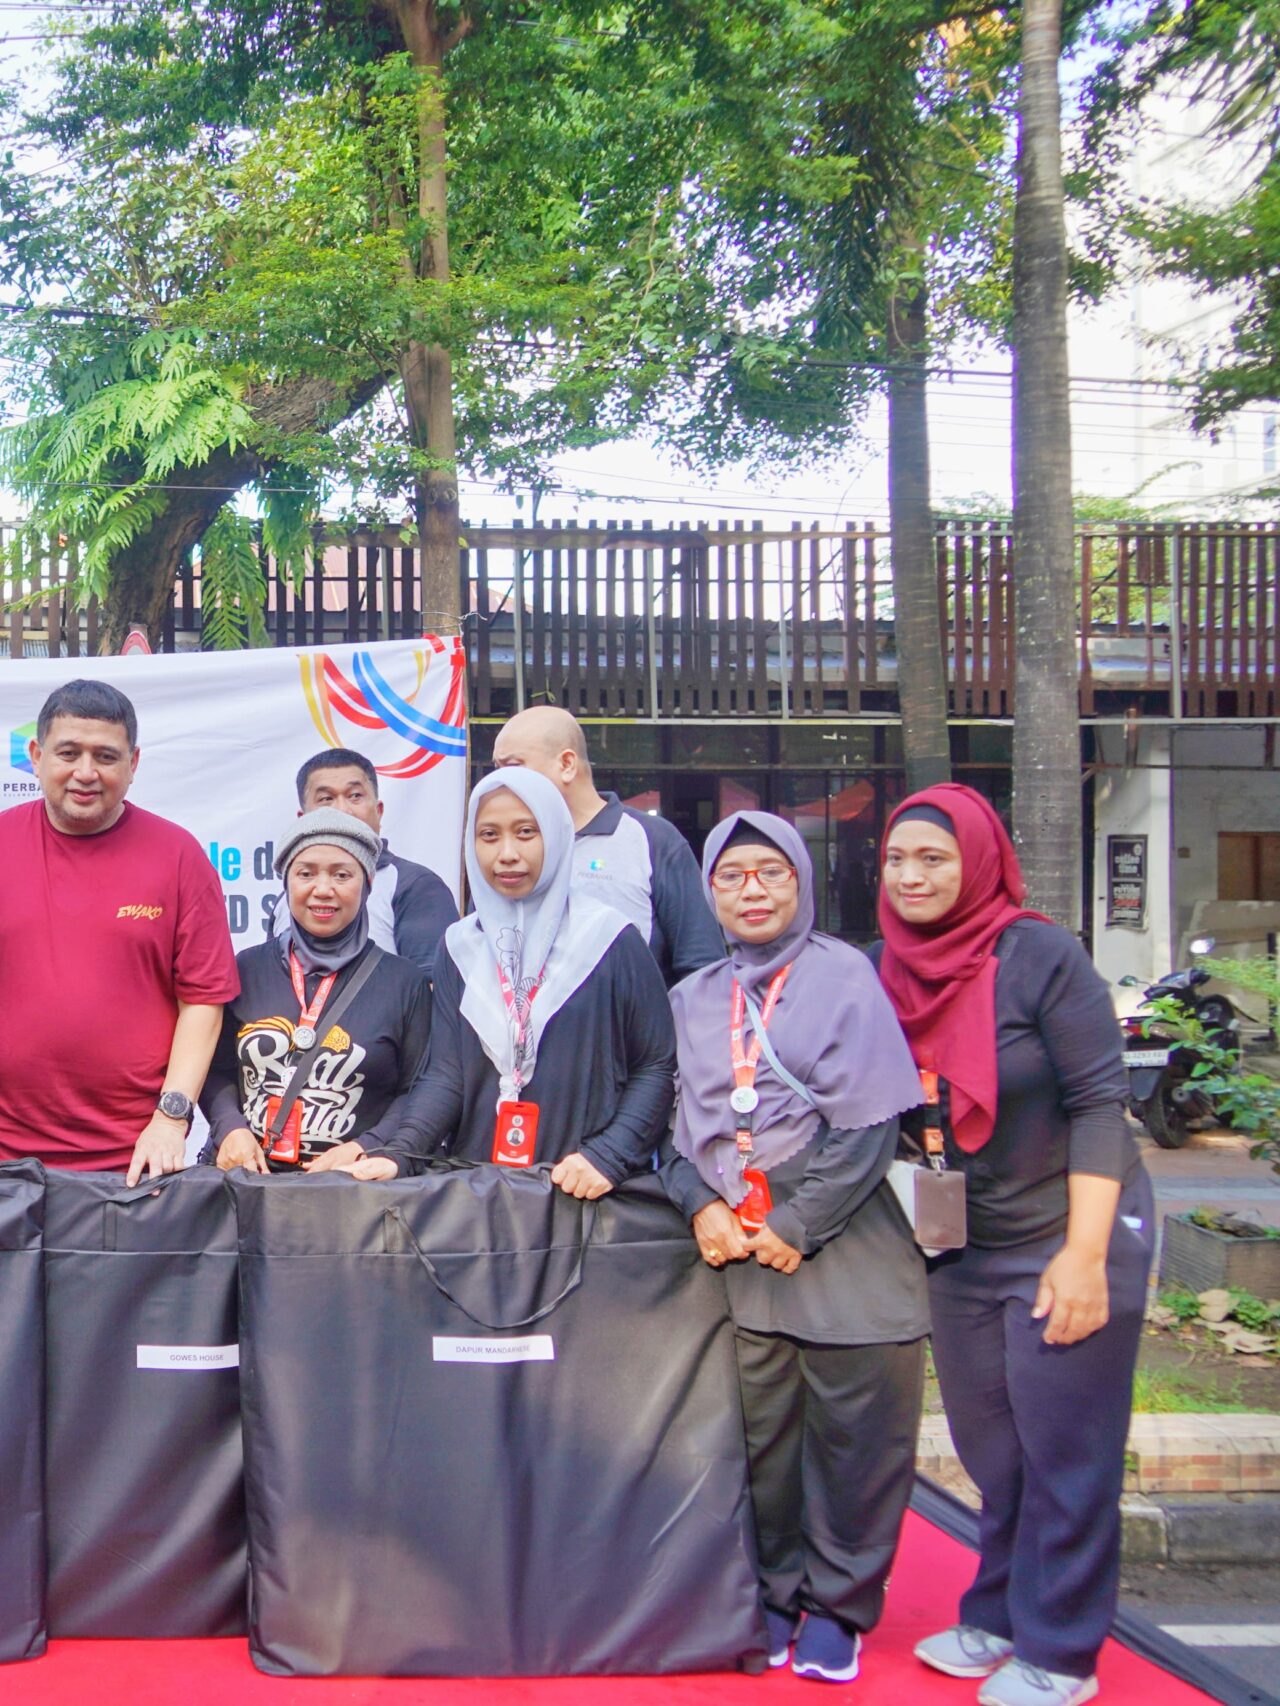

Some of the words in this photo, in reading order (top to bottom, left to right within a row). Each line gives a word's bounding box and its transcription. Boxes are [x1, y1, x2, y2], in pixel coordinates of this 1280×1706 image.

[3, 783, 40, 792] PERB
[116, 904, 163, 921] EWAKO
[455, 1345, 483, 1354] DAPUR
[199, 1354, 224, 1362] HOUSE
